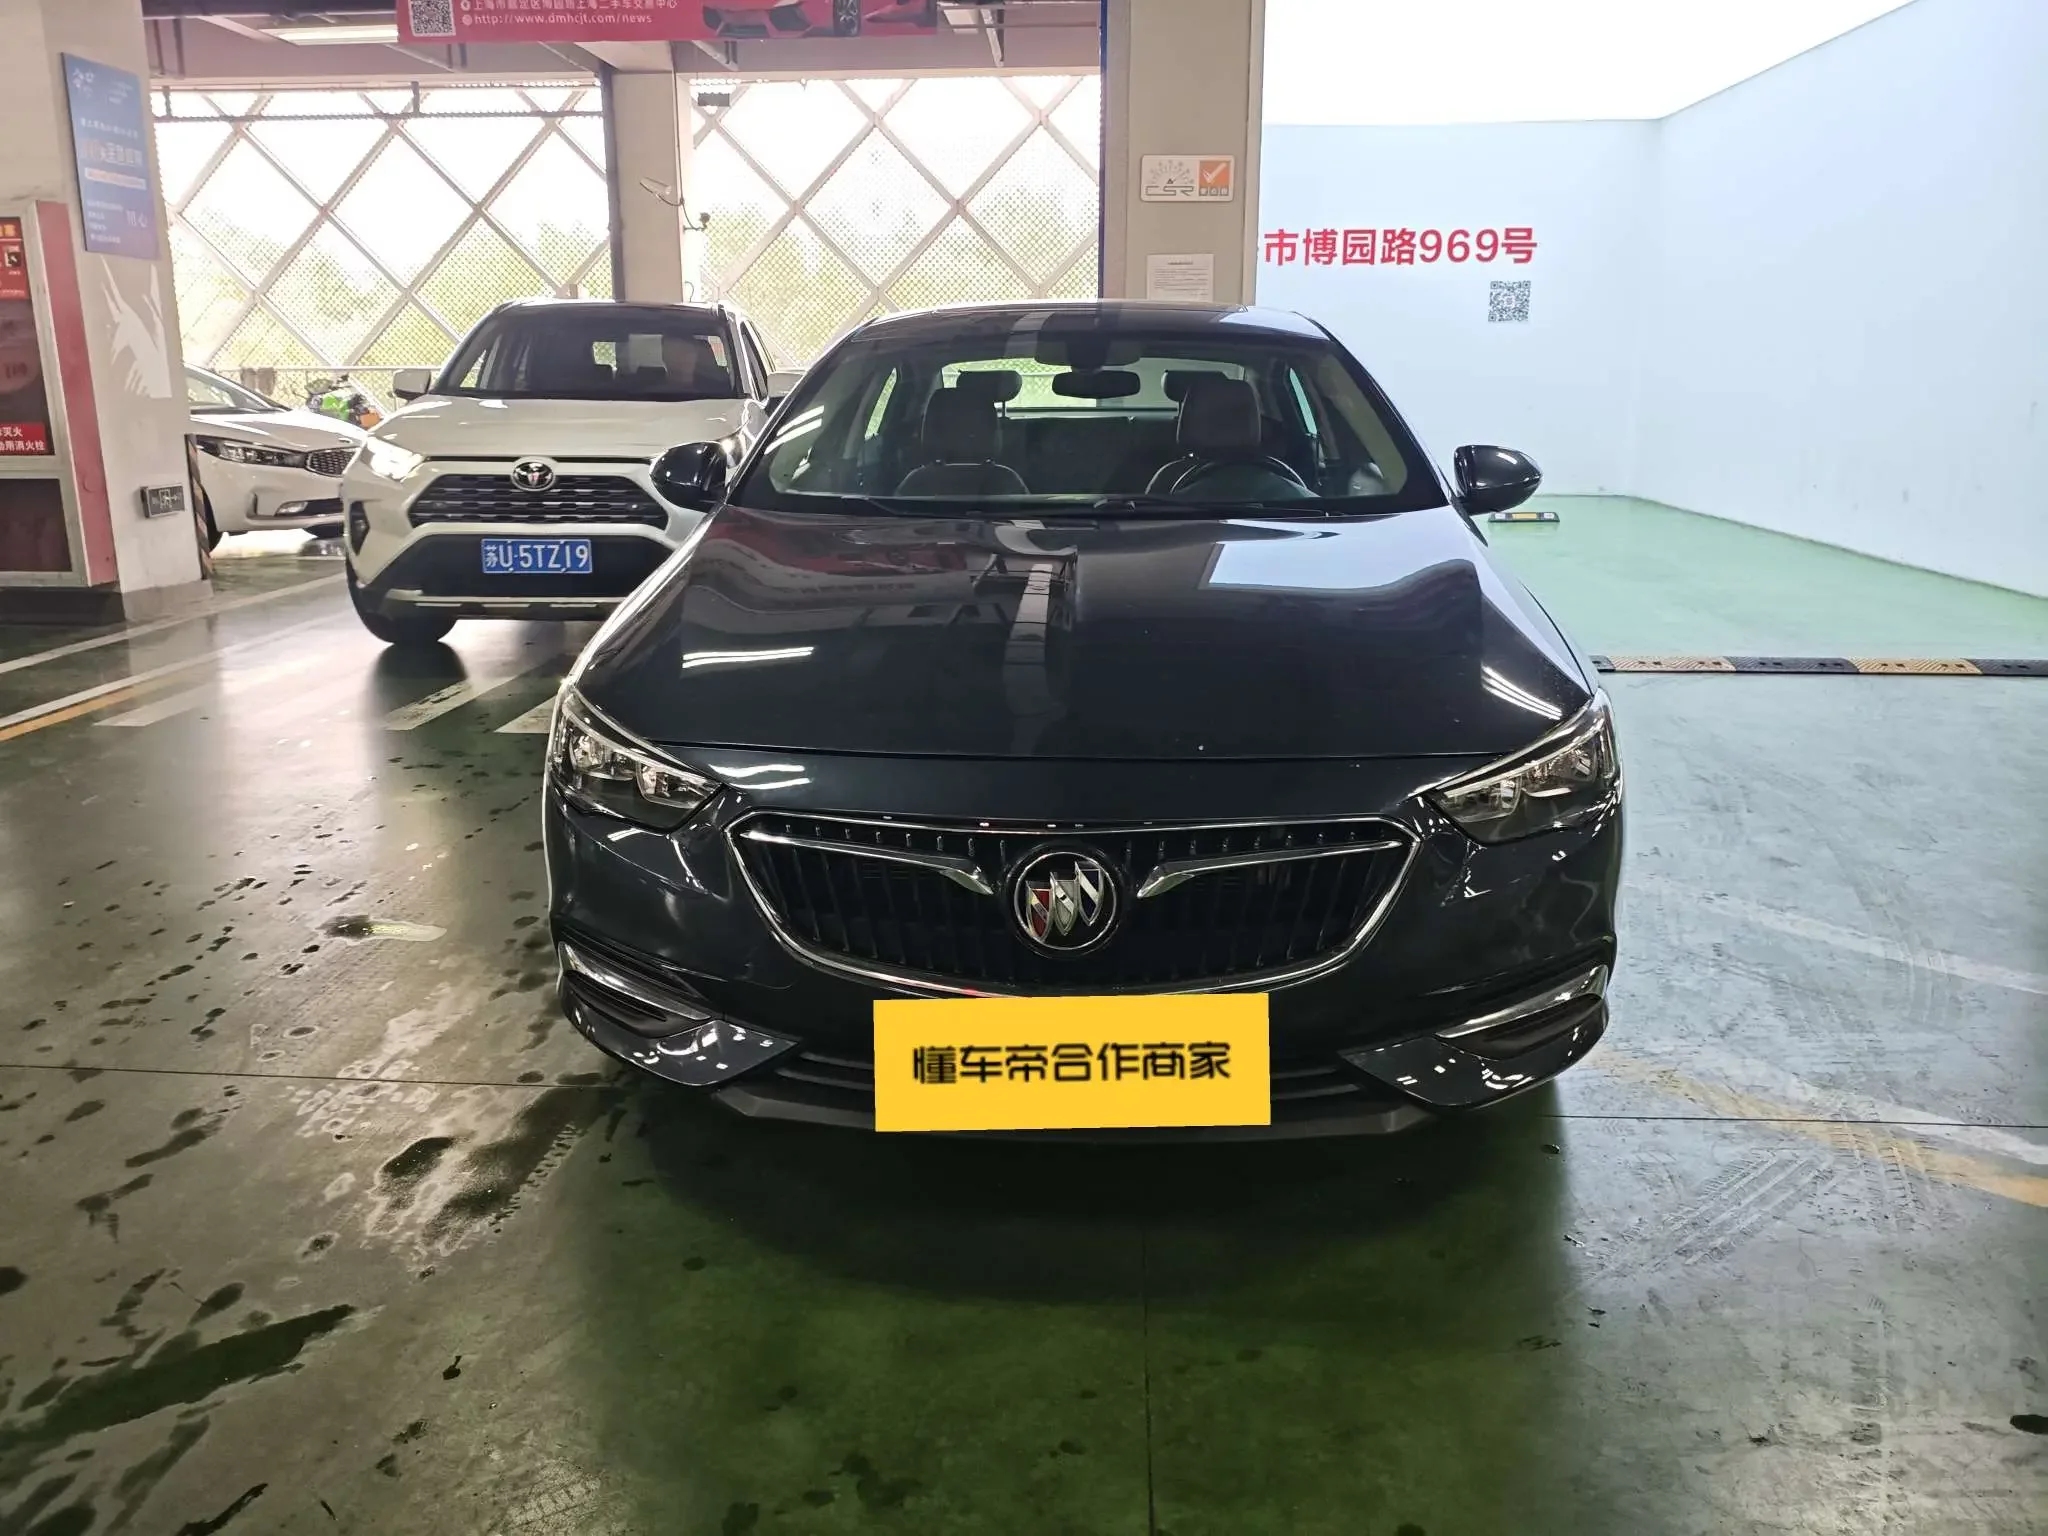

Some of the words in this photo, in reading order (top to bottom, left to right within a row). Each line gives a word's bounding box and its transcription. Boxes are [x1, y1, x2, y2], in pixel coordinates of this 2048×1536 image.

[1263, 227, 1538, 266] 市博园路969号
